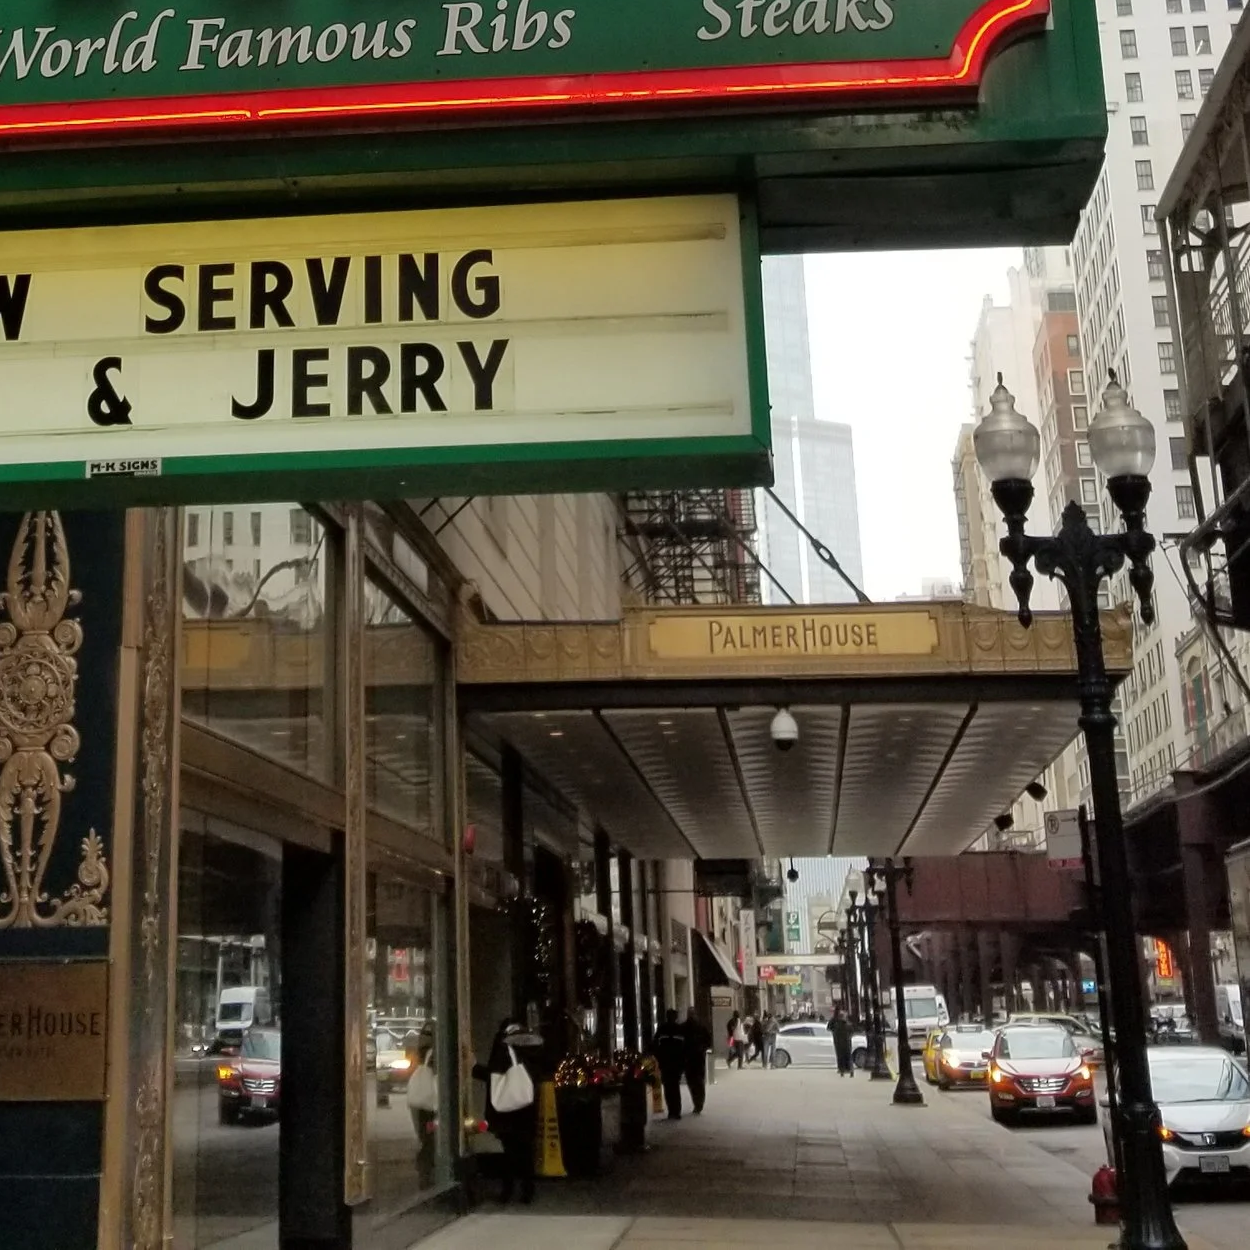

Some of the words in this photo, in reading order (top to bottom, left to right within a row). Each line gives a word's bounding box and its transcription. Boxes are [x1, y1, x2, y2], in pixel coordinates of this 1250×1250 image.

[179, 16, 416, 72] Famous
[144, 250, 502, 333] SERVING
[87, 357, 132, 426] &
[232, 338, 508, 420] JERRY
[119, 460, 158, 471] SIGNS
